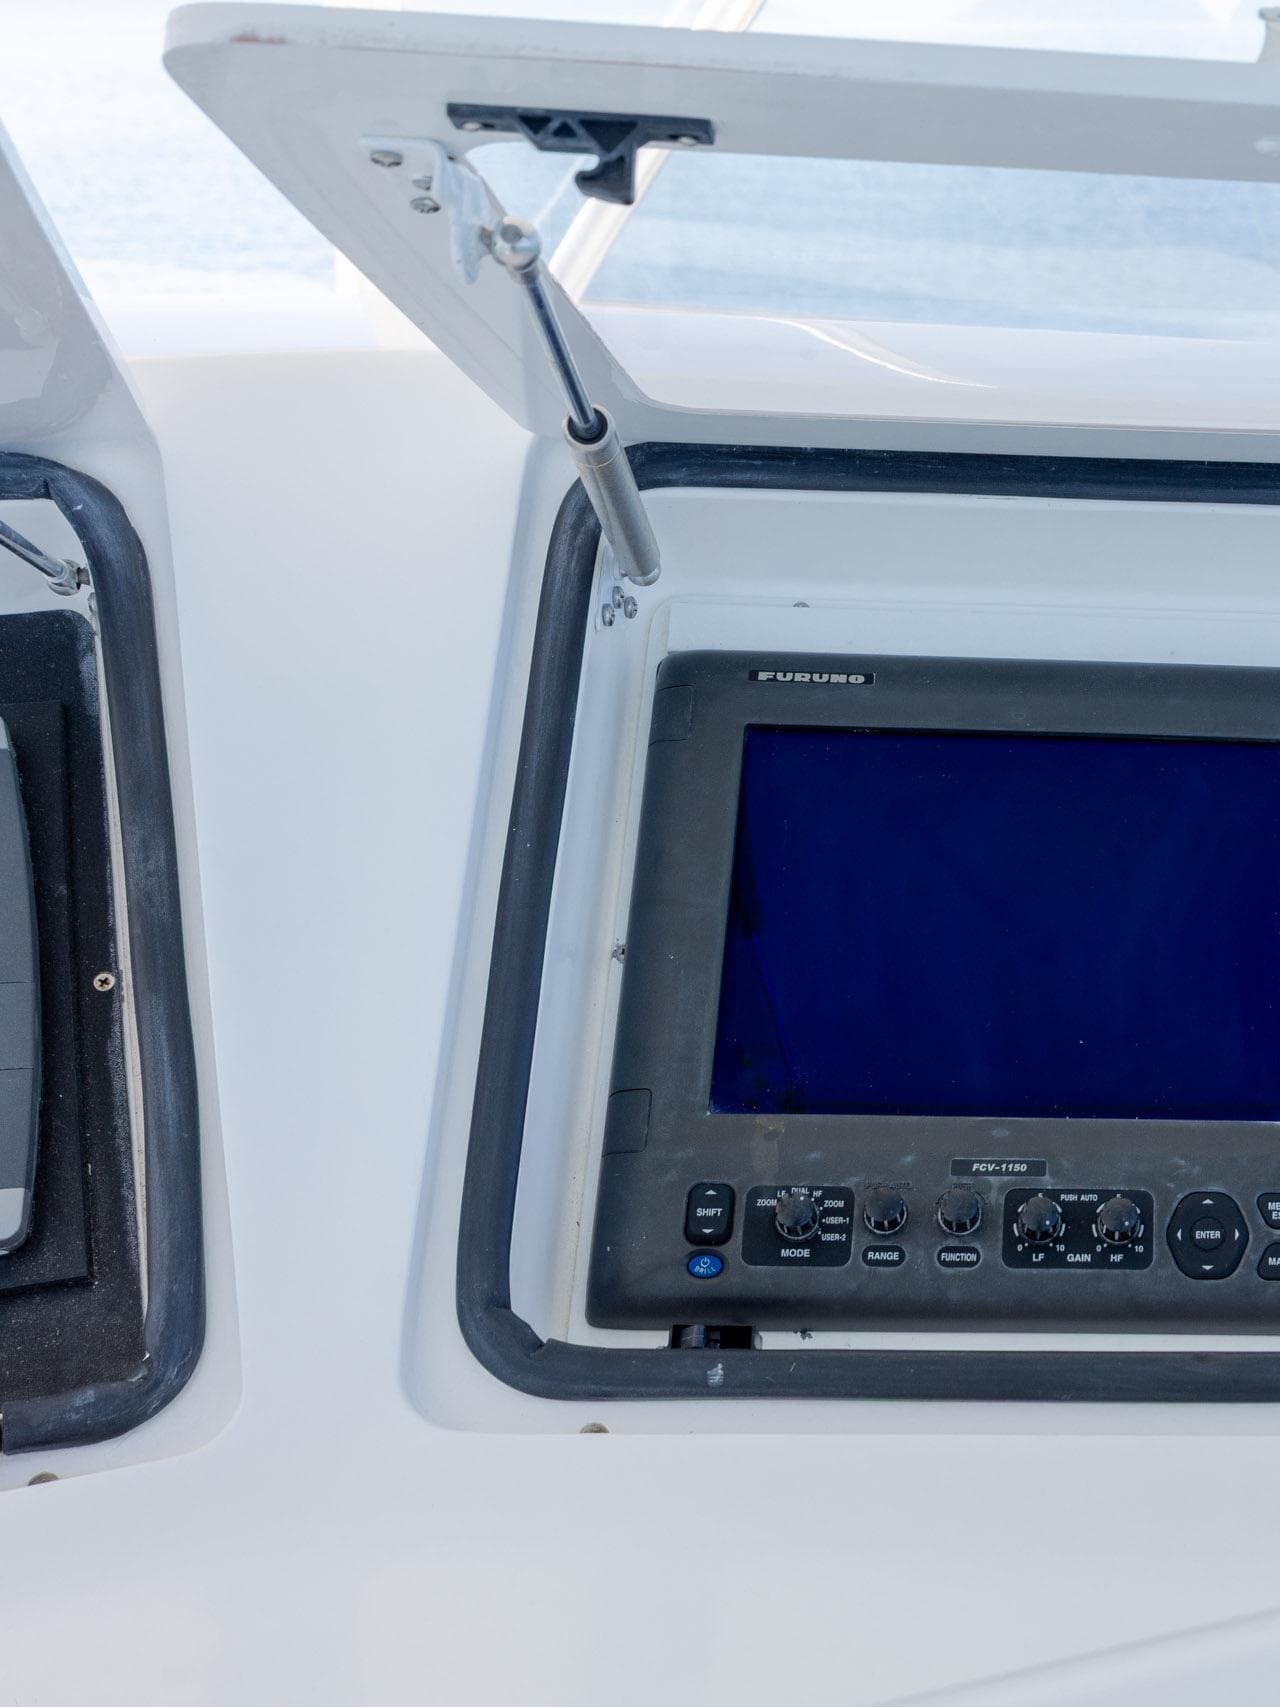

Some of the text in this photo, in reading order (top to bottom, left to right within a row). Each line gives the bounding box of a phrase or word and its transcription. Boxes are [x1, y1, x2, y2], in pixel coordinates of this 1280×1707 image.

[758, 672, 865, 683] FURUNO
[973, 1163, 1027, 1172] FCV-1150
[696, 1208, 722, 1217] SHIFT
[1196, 1230, 1221, 1239] ENTER
[781, 1248, 810, 1258] MODE
[867, 1251, 899, 1260] RANGE
[941, 1253, 977, 1262] FUNCTION
[1033, 1254, 1044, 1262] LF
[1067, 1254, 1091, 1262] GAIN
[1111, 1254, 1123, 1262] HF
